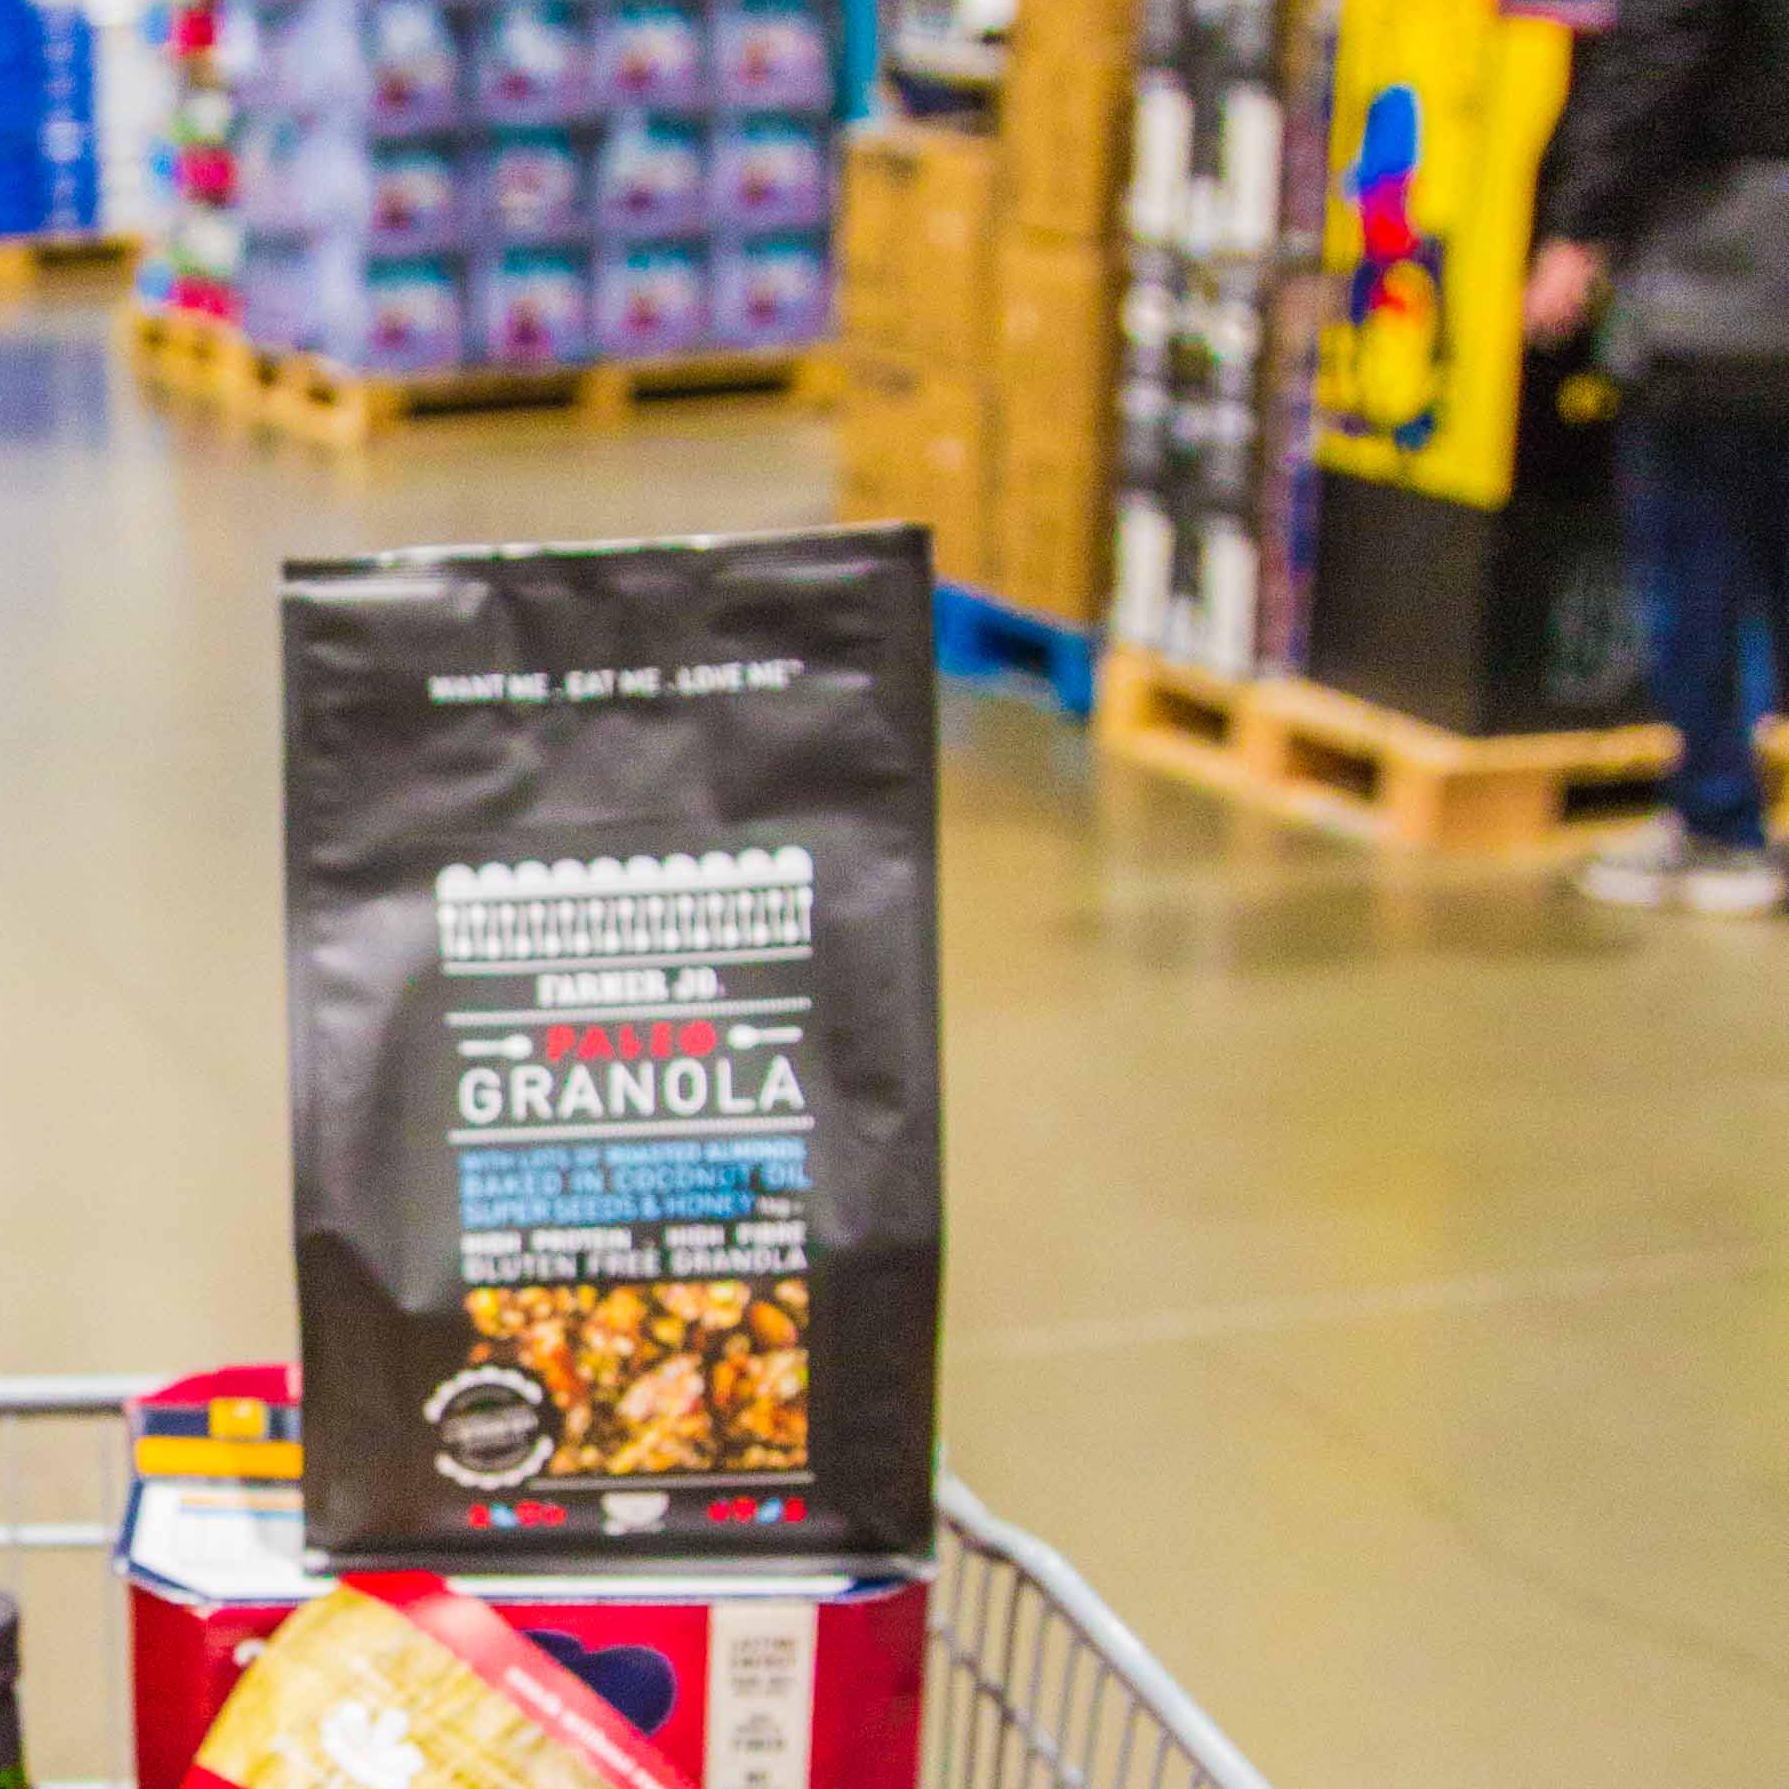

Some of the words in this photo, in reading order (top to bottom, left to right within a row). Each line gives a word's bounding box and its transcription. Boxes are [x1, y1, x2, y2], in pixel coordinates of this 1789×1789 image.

[546, 1020, 716, 1062] PALEO
[458, 1054, 806, 1125] GRANOLA
[668, 1245, 809, 1277] GRANOLA
